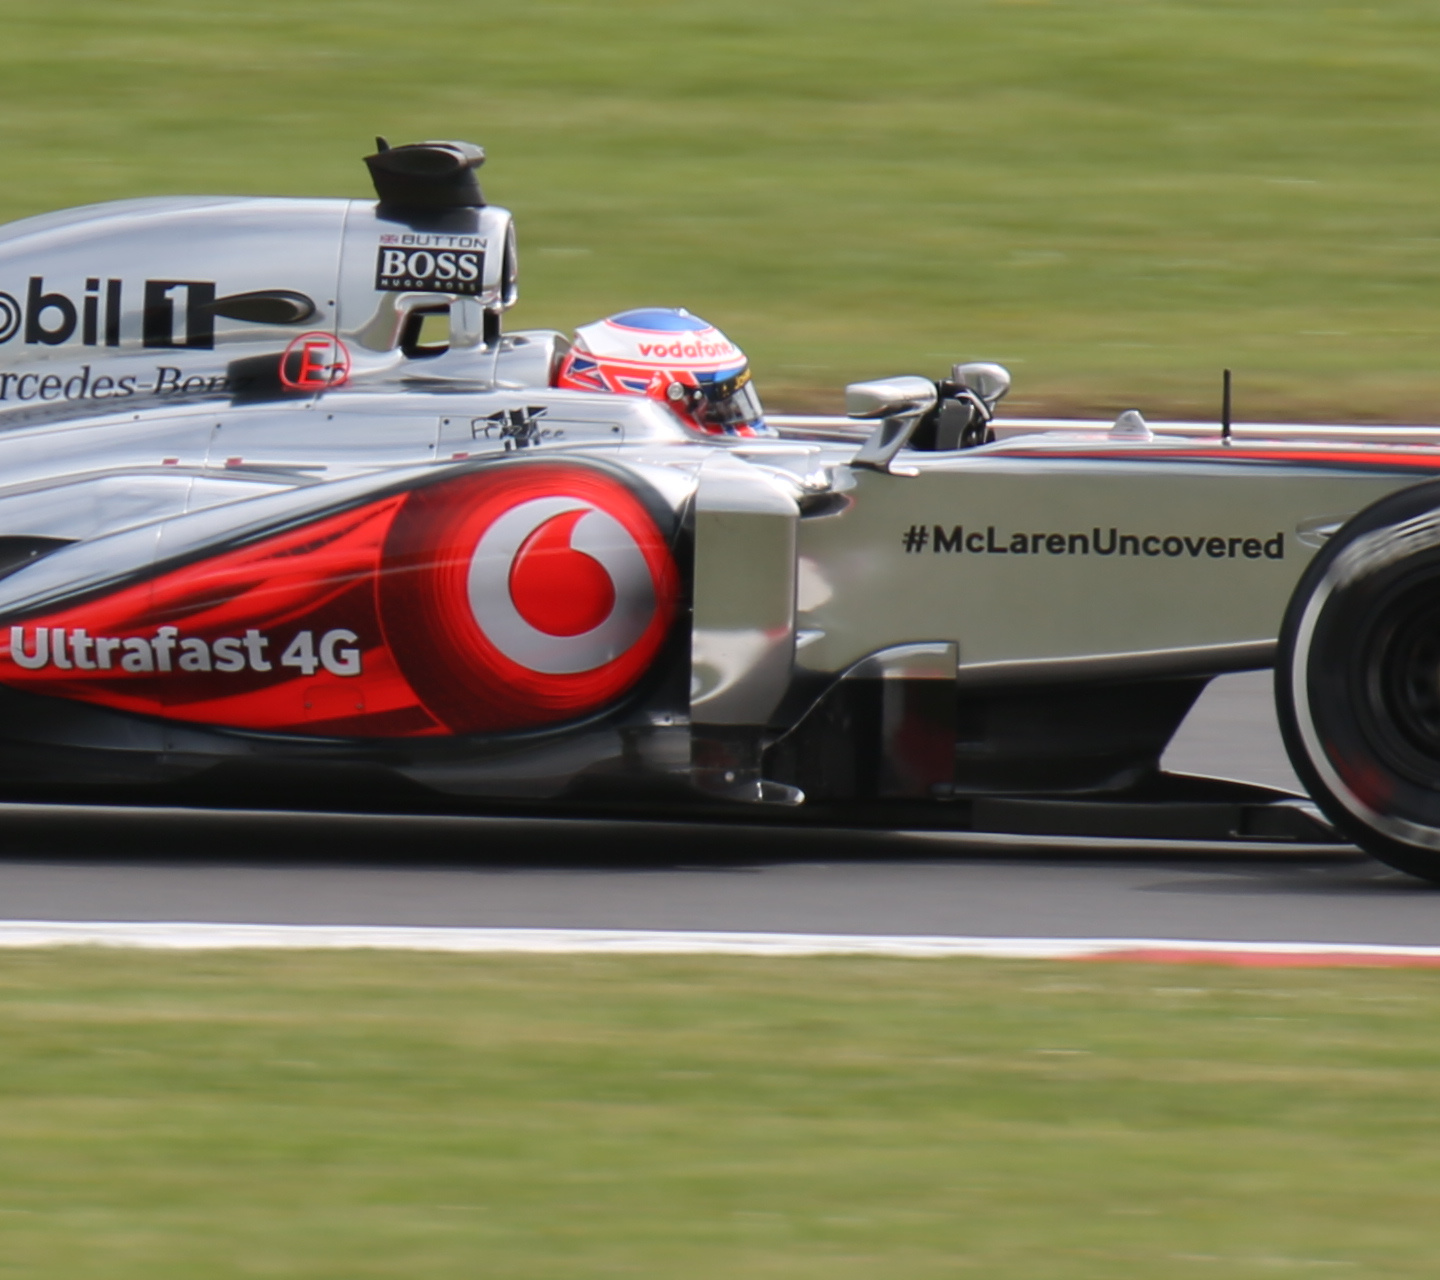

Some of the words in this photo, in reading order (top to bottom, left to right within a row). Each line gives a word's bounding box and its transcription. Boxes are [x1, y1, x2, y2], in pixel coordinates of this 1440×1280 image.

[401, 234, 488, 249] BUTTON
[381, 250, 479, 281] BOSS
[381, 279, 424, 288] HUGO
[434, 281, 477, 291] BOSS
[298, 342, 331, 384] E
[902, 525, 1284, 560] #McLarenUncovered
[9, 626, 272, 672] Ultrafast
[281, 629, 361, 677] 4G
